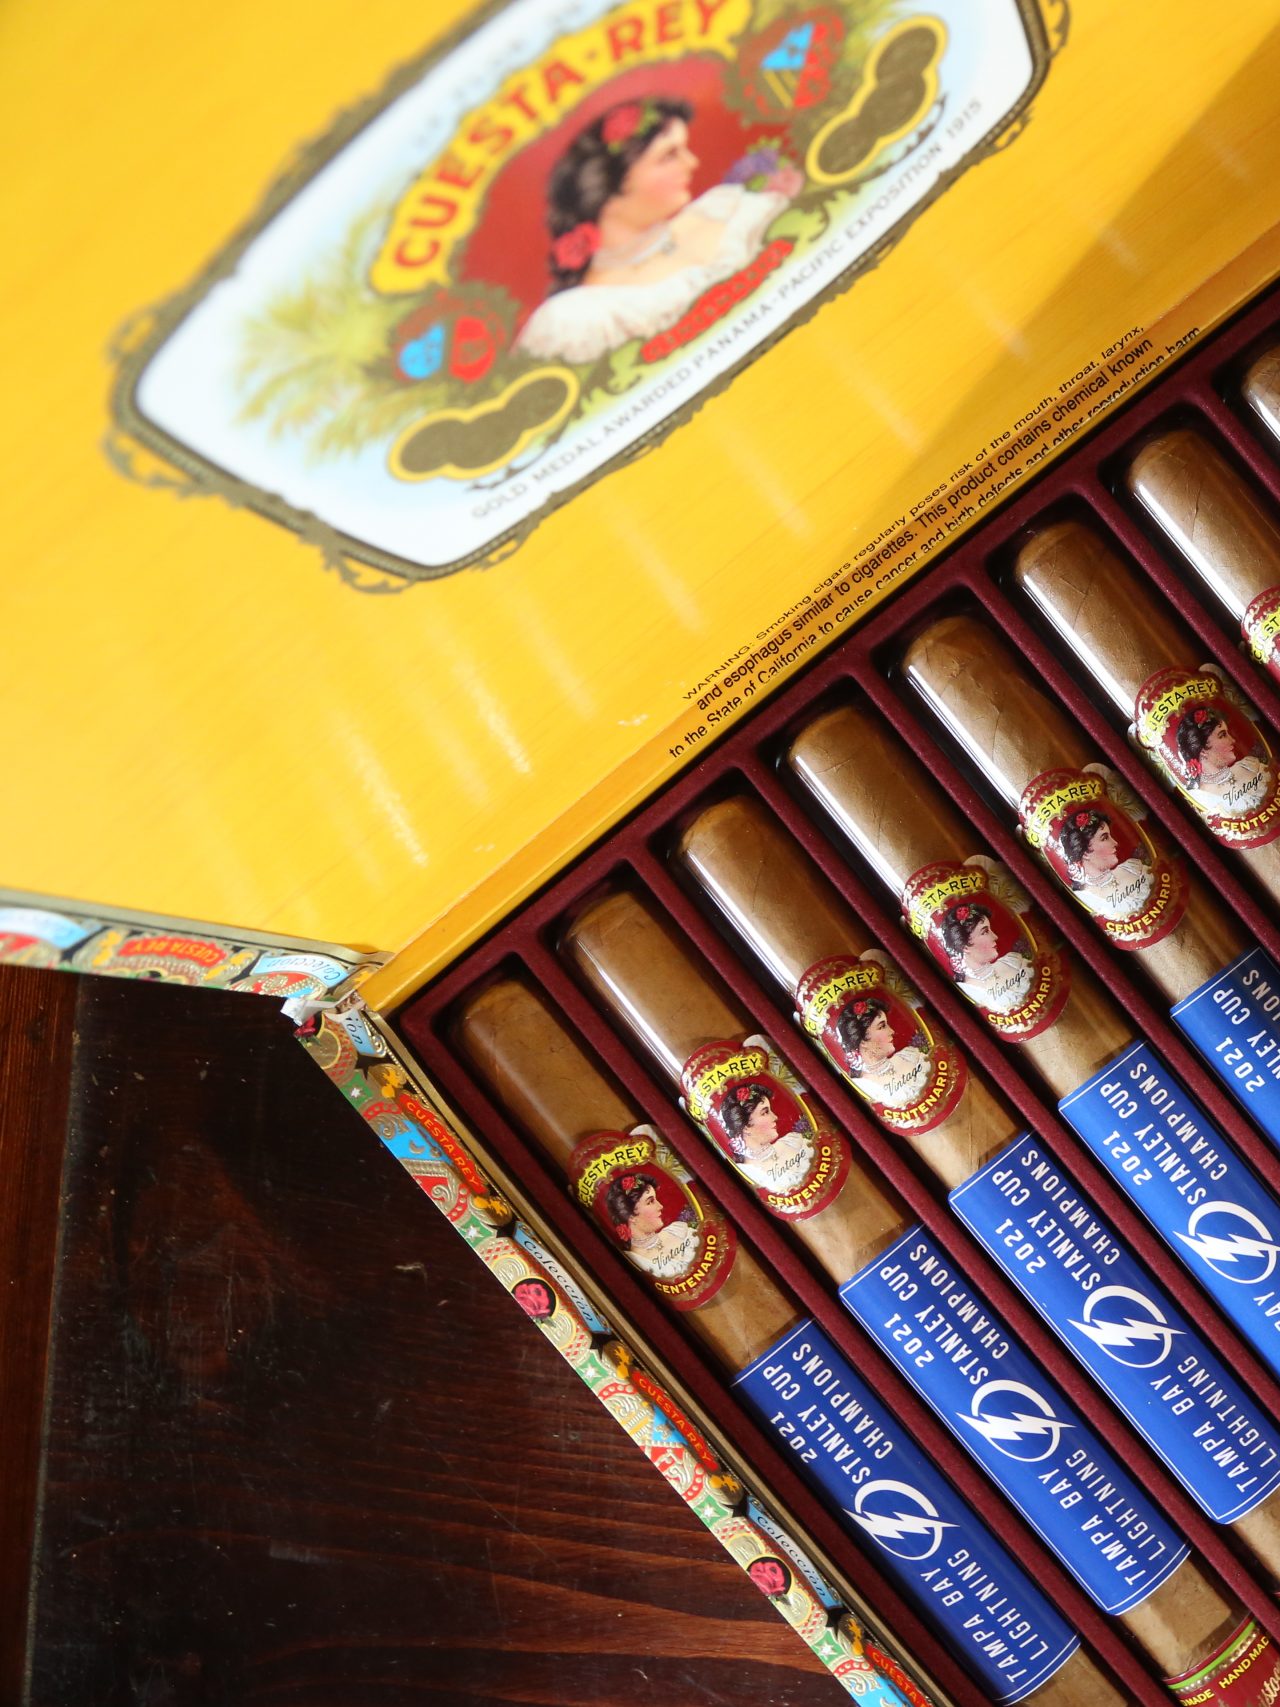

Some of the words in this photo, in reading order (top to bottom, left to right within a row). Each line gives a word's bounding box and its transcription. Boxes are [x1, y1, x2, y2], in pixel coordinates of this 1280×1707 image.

[471, 476, 529, 526] GOLD
[530, 429, 599, 488] MEDAL
[599, 361, 693, 439] AWARDED
[843, 141, 945, 240] EXPOSITION
[942, 96, 985, 139] 1915
[682, 645, 751, 700] WARNING:
[755, 595, 812, 639] Smoking
[813, 562, 851, 594] cigars
[853, 515, 906, 561] regularly
[909, 483, 948, 517] poses
[949, 462, 974, 483] risk
[975, 448, 988, 462] of
[990, 431, 1011, 449] the
[1013, 396, 1058, 431] mouth,
[1101, 326, 1141, 360] larynx,
[696, 683, 723, 711] and
[723, 628, 793, 688] esophagus
[792, 592, 835, 631] similar
[834, 581, 851, 596] to
[851, 530, 914, 584] cigarettes.
[914, 503, 948, 528] This
[946, 461, 998, 508] product
[997, 419, 1052, 466] contains
[1052, 370, 1110, 422] chemical
[1106, 339, 1153, 377] known
[669, 744, 685, 758] to
[684, 725, 706, 745] the
[706, 696, 742, 722] State
[743, 679, 757, 697] of
[757, 633, 817, 684] California
[818, 621, 834, 635] to
[835, 589, 873, 623] cause
[875, 551, 918, 590] cancer
[1223, 772, 1264, 807] Vintage
[1105, 872, 1171, 934] CENTENARIO
[1106, 874, 1147, 908] Vintage
[987, 968, 1027, 1000] Vintage
[987, 965, 1052, 1026] CENTENARIO
[1212, 988, 1251, 1025] CUP
[693, 1058, 758, 1115] CUSTA-REY
[882, 1060, 948, 1122] CENTENARIO
[884, 1063, 923, 1096] Vintage
[1215, 1036, 1266, 1093] 2021
[1099, 1081, 1138, 1119] CUP
[1129, 1062, 1228, 1181] CHAMPIONS
[766, 1145, 831, 1206] CENTENARIO
[768, 1148, 806, 1182] Vintage
[991, 1169, 1031, 1207] CUP
[1102, 1130, 1153, 1186] 2021
[1133, 1123, 1207, 1205] STANLEY
[1021, 1149, 1120, 1265] CHAMPIONS
[652, 1237, 691, 1270] Vintage
[655, 1234, 717, 1295] CENTENARIO
[995, 1218, 1047, 1274] 2021
[1026, 1209, 1101, 1291] STANLEY
[879, 1264, 919, 1302] CUP
[909, 1244, 1009, 1360] CHAMPIONS
[884, 1312, 935, 1368] 2021
[914, 1304, 989, 1385] STANLEY
[762, 1364, 801, 1401] CUP
[792, 1343, 893, 1459] CHAMPIONS
[1149, 1374, 1195, 1416] BAY
[1177, 1355, 1277, 1468] LIGHTNING
[770, 1411, 818, 1464] 2021
[797, 1404, 871, 1484] STANLEY
[1192, 1420, 1258, 1493] TAMPA
[1038, 1468, 1083, 1510] BAY
[1065, 1449, 1166, 1561] LIGHTNING
[1080, 1514, 1146, 1586] TAMPA
[920, 1567, 965, 1607] BAY
[946, 1549, 1049, 1661] LIGHTNING
[962, 1613, 1027, 1683] TAMPA
[1218, 1657, 1252, 1689] HAND
